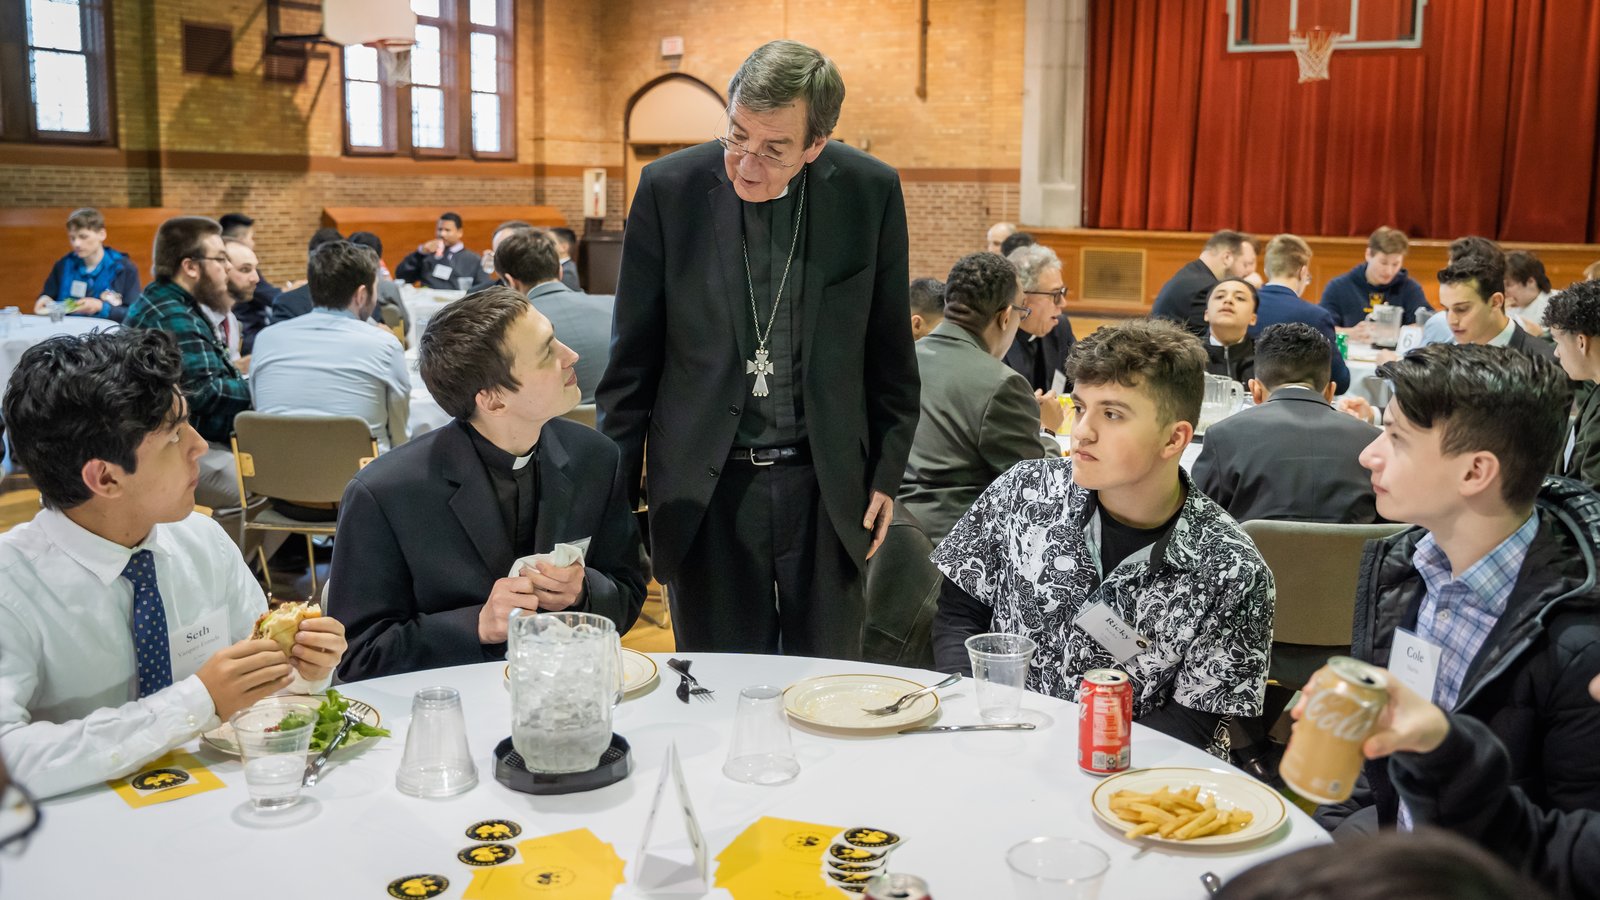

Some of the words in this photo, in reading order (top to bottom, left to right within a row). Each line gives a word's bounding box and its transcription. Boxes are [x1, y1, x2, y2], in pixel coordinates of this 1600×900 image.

[1403, 334, 1413, 348] 6
[186, 626, 210, 643] Seth
[1105, 617, 1131, 640] Ricky
[1407, 646, 1425, 663] Cole
